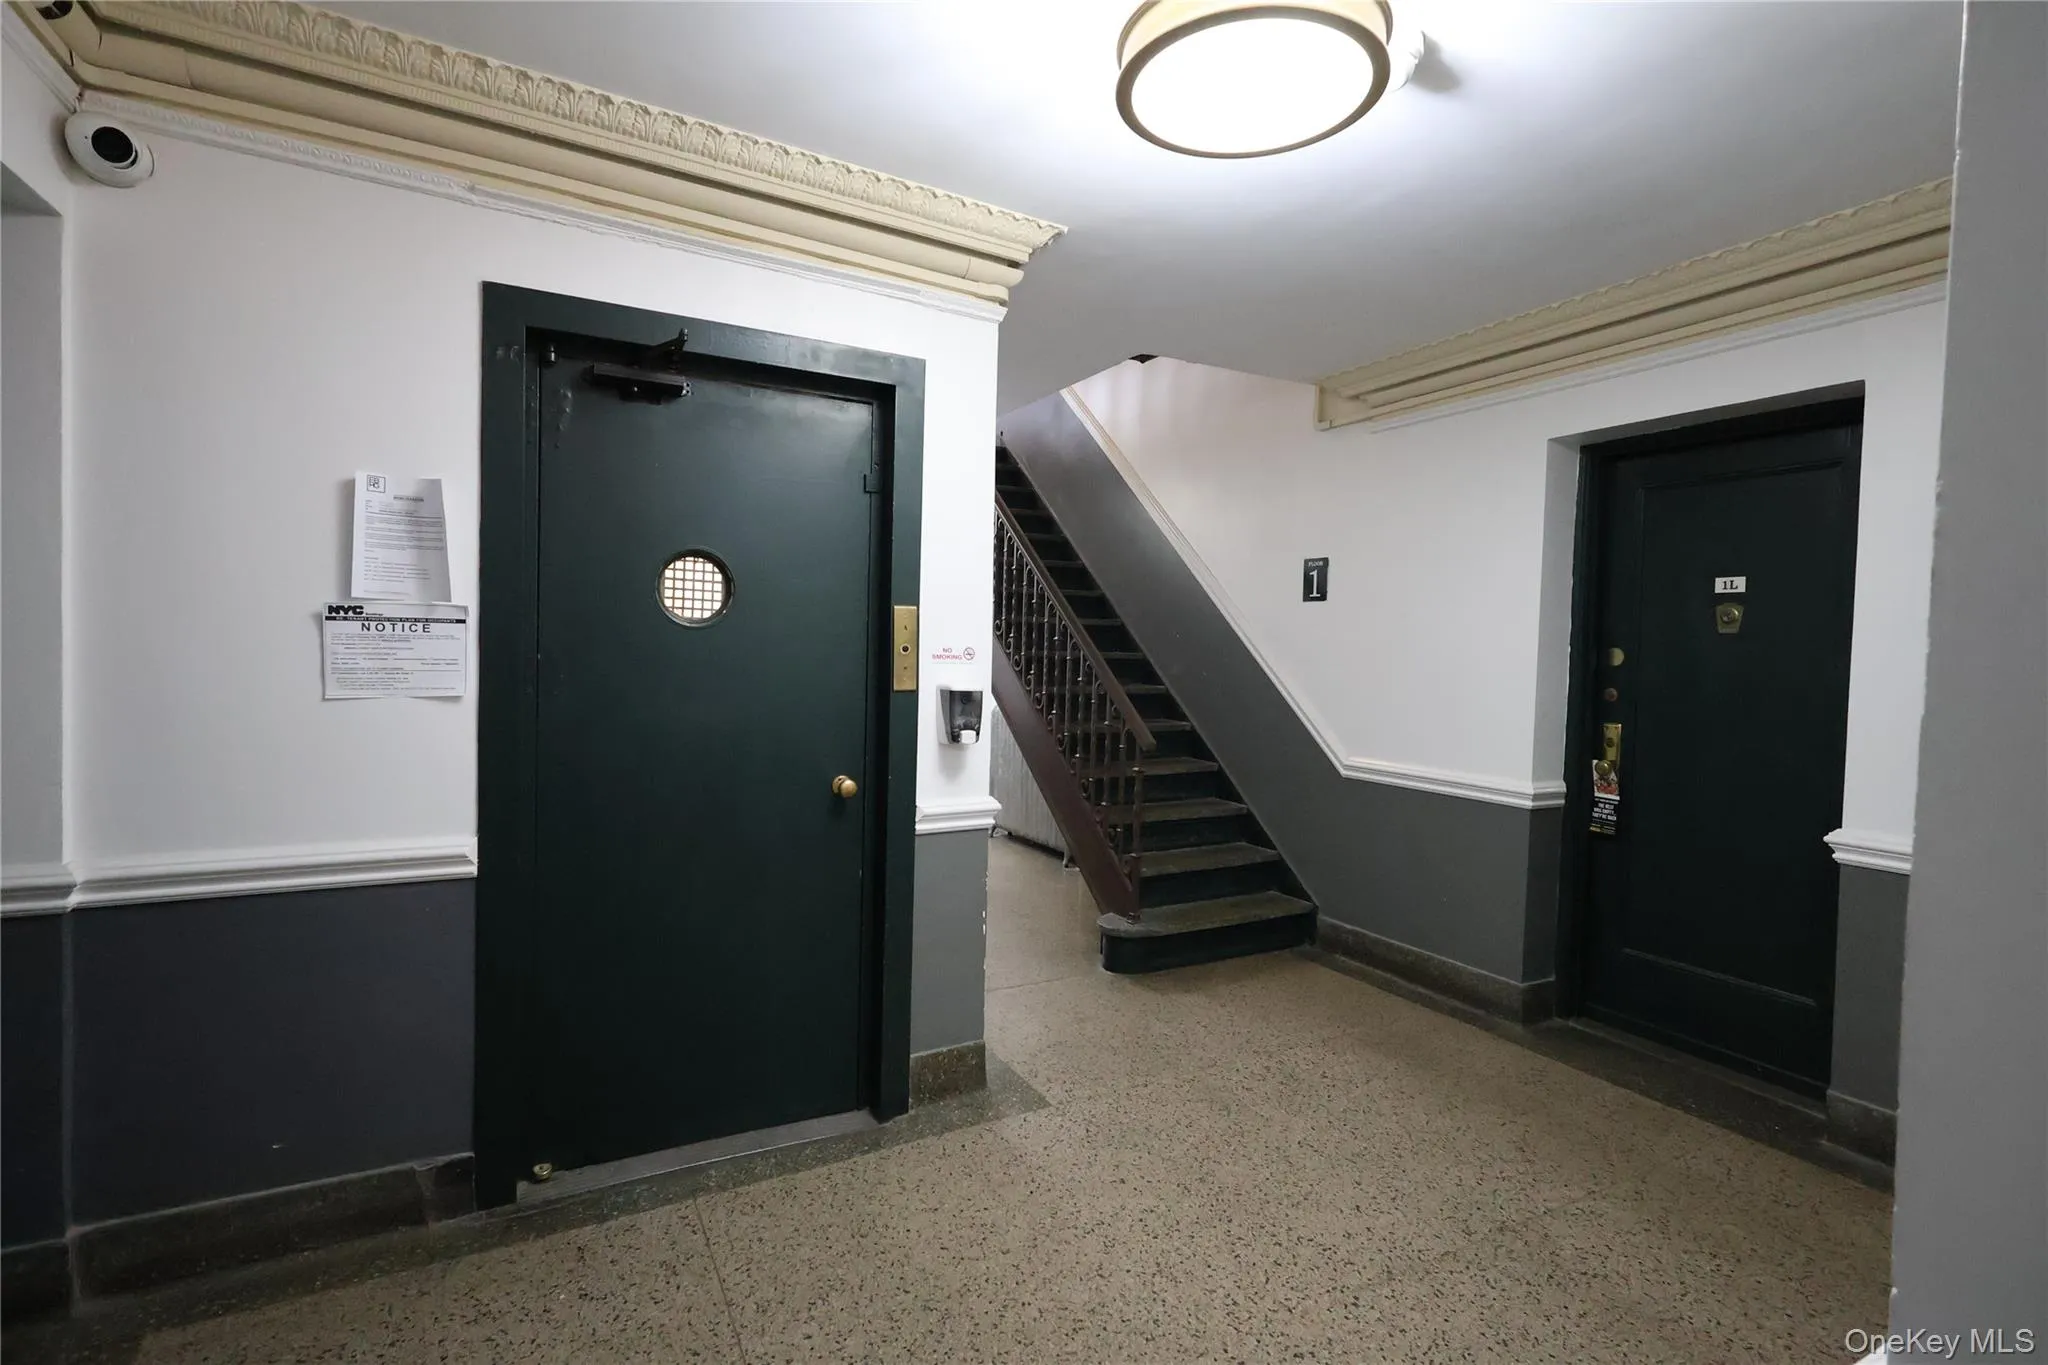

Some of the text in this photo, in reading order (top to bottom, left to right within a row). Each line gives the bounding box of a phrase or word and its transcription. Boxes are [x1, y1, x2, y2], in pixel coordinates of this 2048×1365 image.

[1309, 569, 1321, 598] 1
[1722, 579, 1739, 590] 1L
[327, 604, 365, 616] NYC
[361, 622, 431, 633] NOTICE
